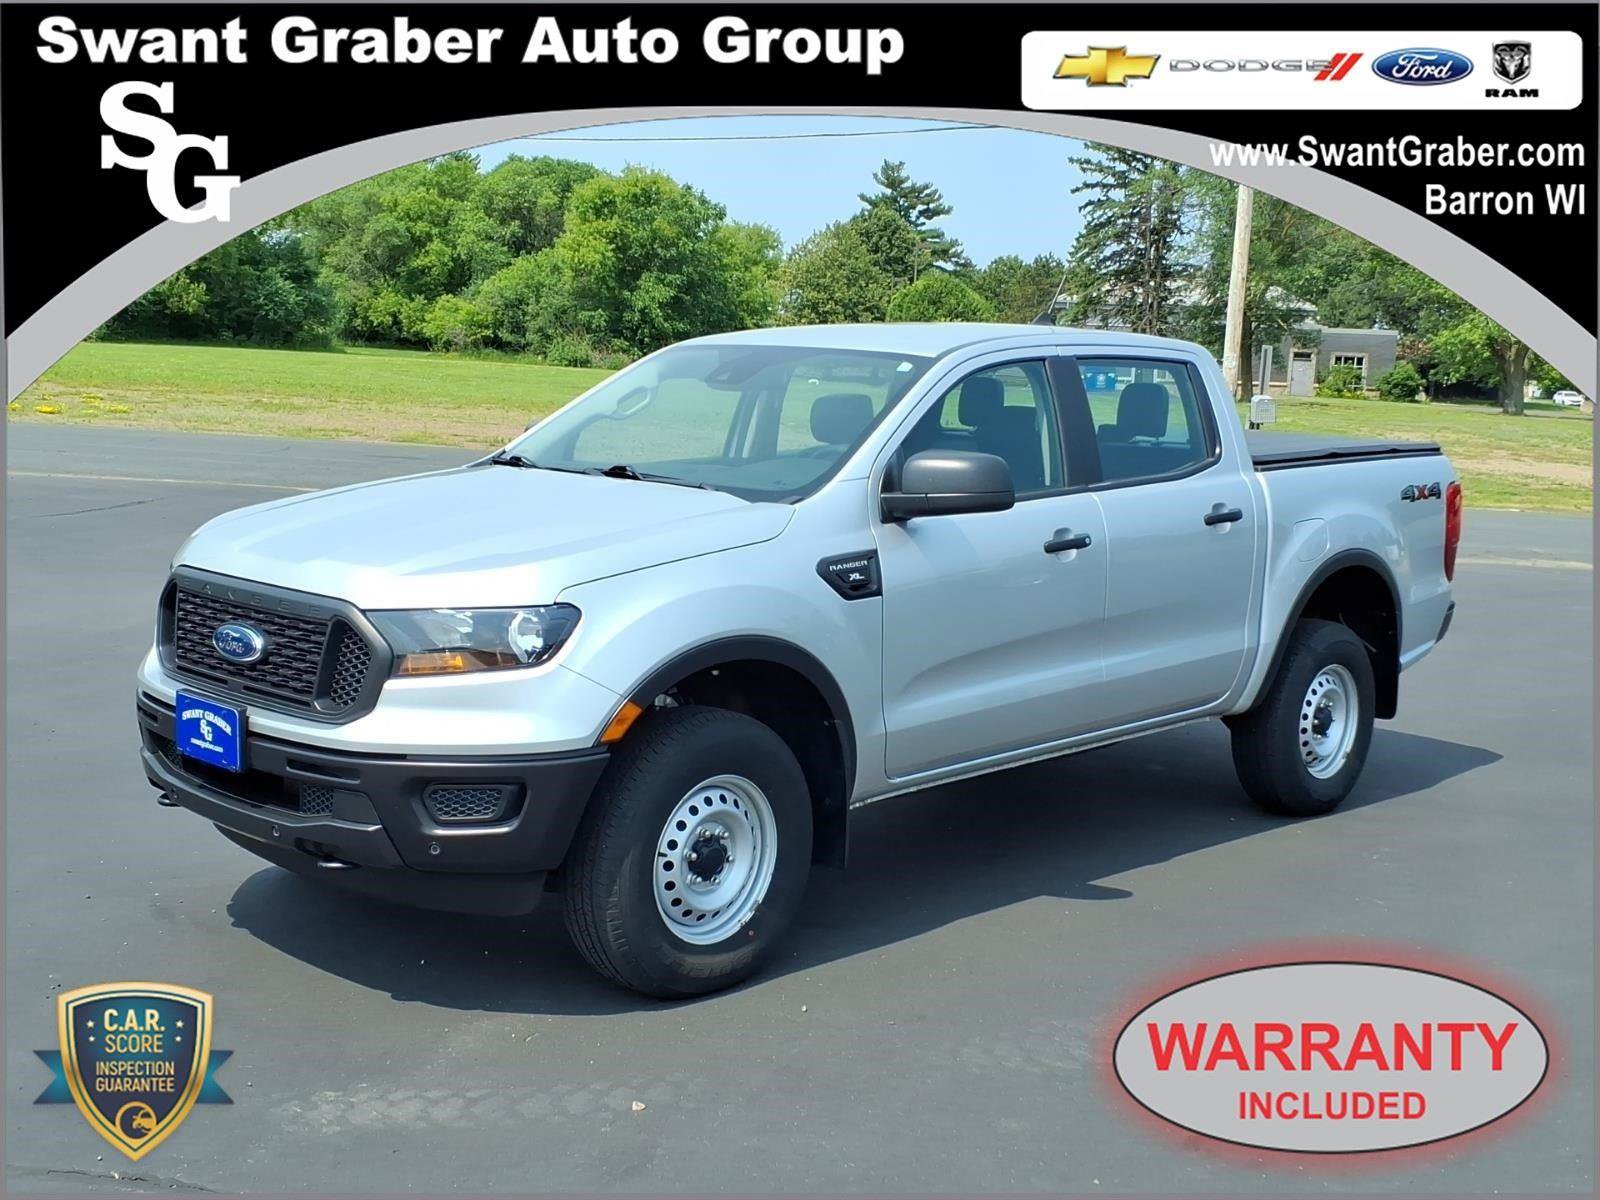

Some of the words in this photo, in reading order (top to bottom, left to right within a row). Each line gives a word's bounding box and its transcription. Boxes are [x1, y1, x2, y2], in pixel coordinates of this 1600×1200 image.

[829, 560, 868, 572] RANGER
[848, 572, 865, 581] XL
[181, 708, 205, 721] SWANT
[204, 711, 232, 736] GRABER
